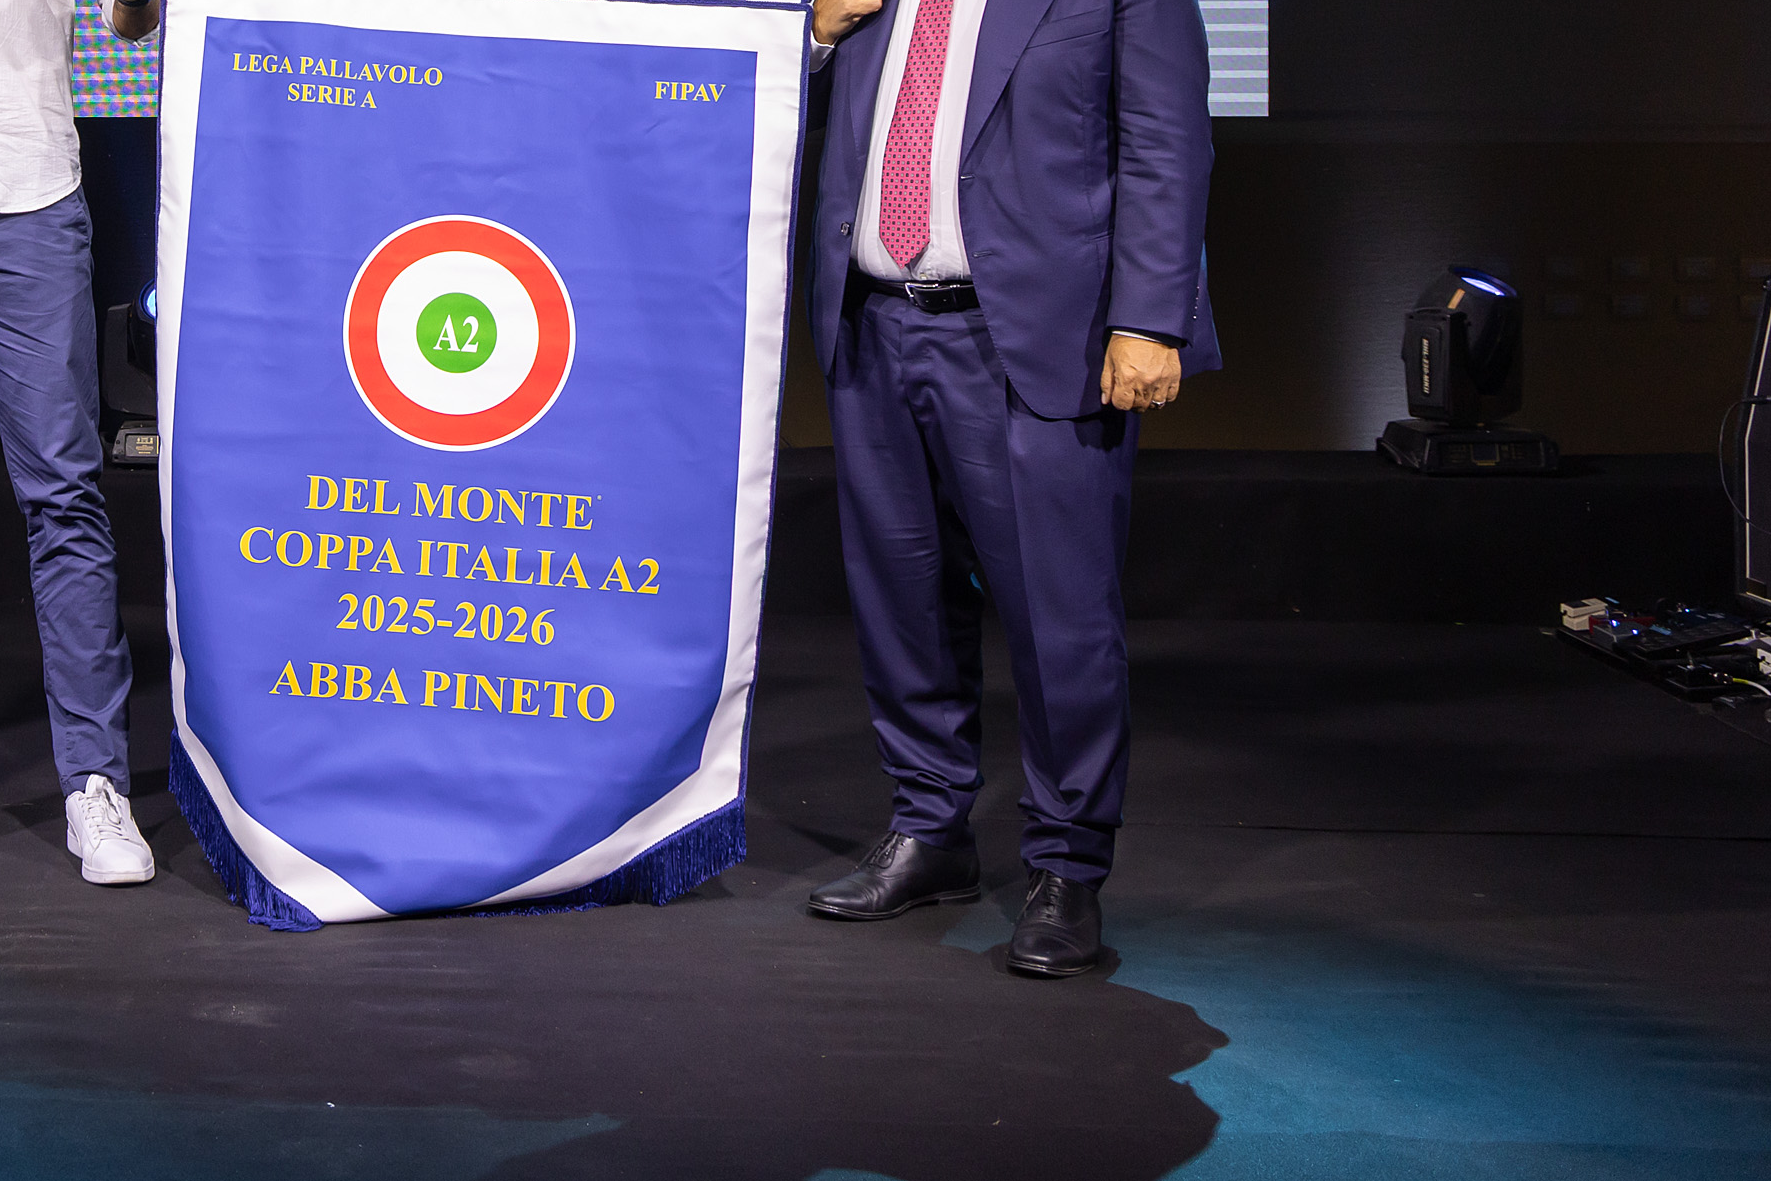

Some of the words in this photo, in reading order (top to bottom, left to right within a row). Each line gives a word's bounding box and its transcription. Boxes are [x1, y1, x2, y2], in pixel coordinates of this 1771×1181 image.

[232, 53, 294, 75] LEGA
[299, 55, 444, 87] PALLAVOLO
[654, 81, 726, 103] FIPAV
[287, 83, 357, 107] SERIE
[360, 91, 377, 109] A
[433, 314, 480, 354] A2
[304, 474, 402, 516] DEL
[411, 482, 595, 531] MONTE
[239, 526, 405, 576] COPPA
[415, 539, 591, 590] ITALIA
[599, 555, 661, 595] A2
[336, 593, 556, 646] 2025-2026
[269, 660, 409, 706] ABBA
[421, 670, 616, 723] PINETO
